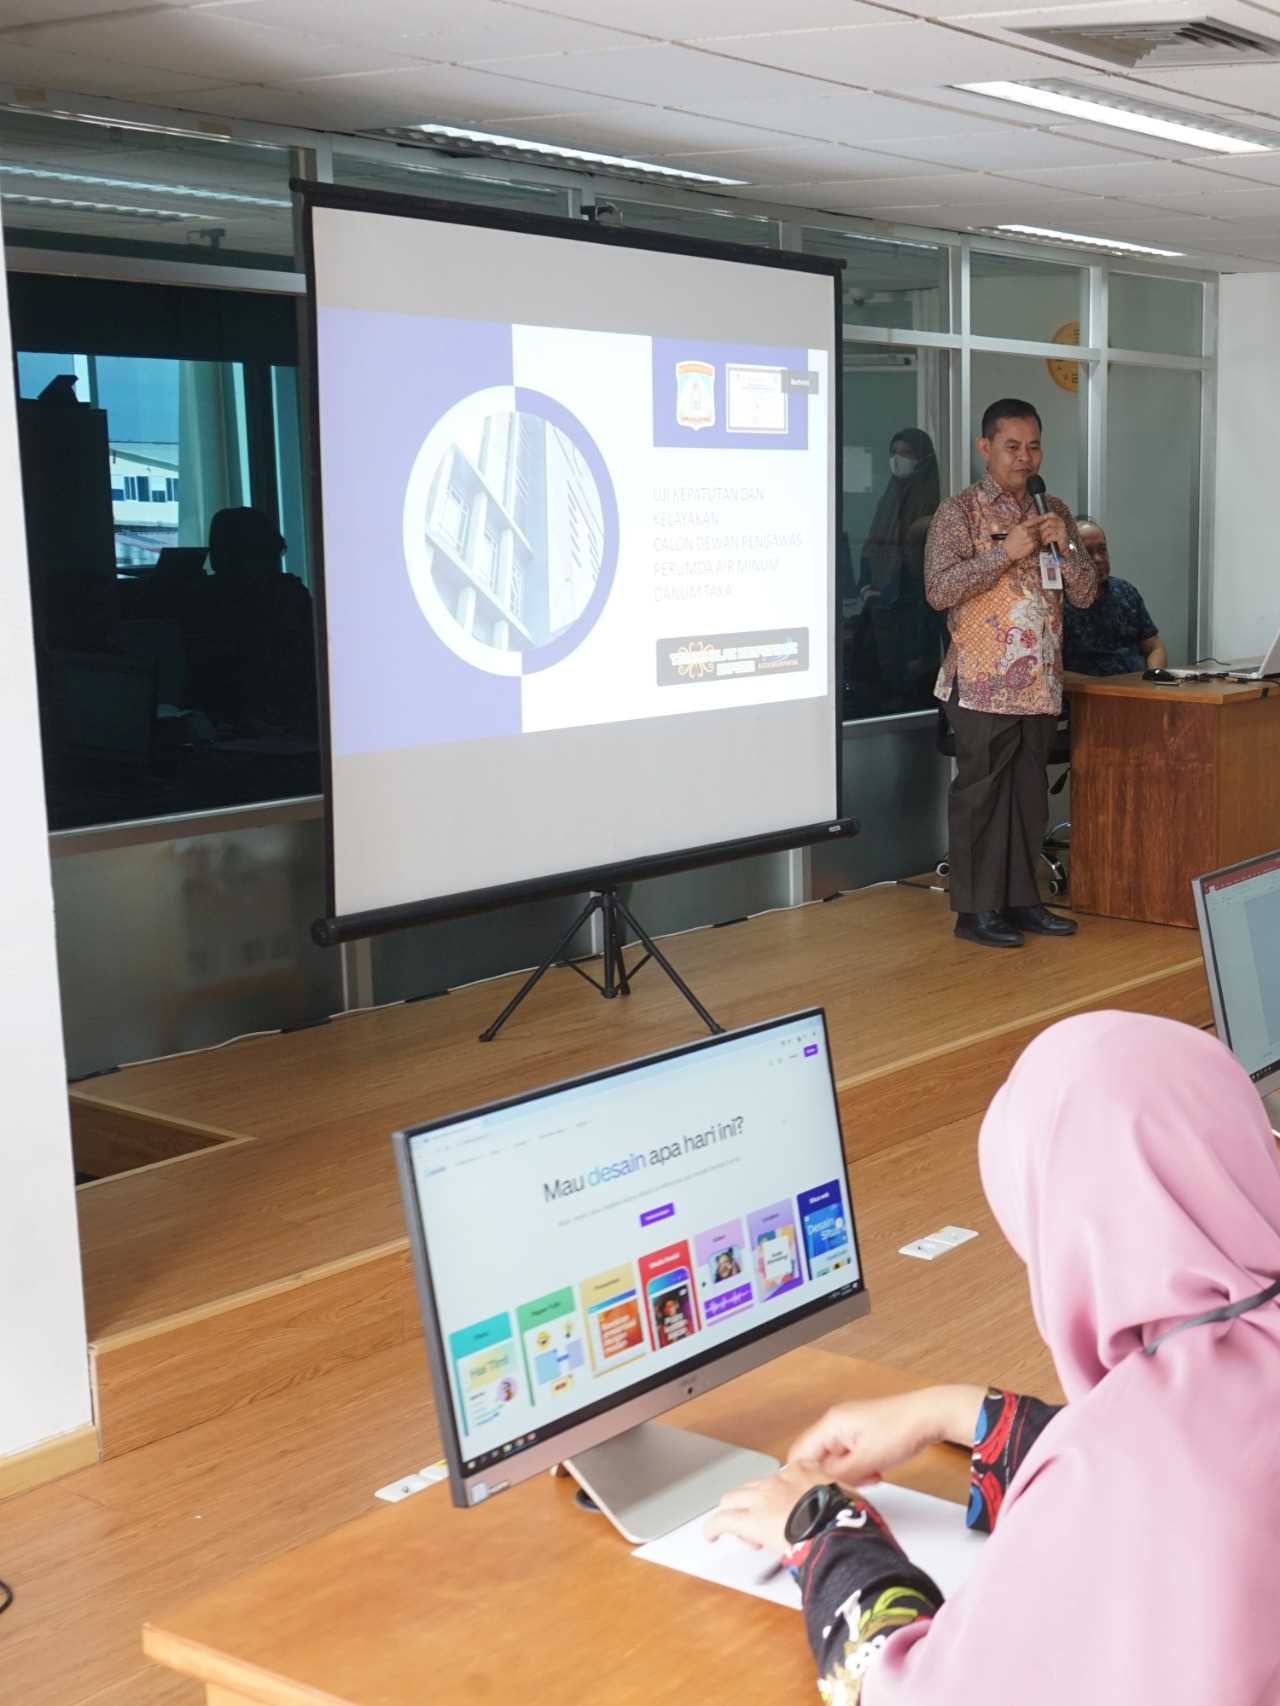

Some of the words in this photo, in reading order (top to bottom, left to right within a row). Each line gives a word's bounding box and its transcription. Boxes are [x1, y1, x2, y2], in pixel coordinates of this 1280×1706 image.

[543, 1175, 585, 1202] Mau
[587, 1153, 647, 1186] desain
[649, 1142, 683, 1166] apa
[682, 1126, 716, 1153] hari
[718, 1115, 744, 1142] ini?
